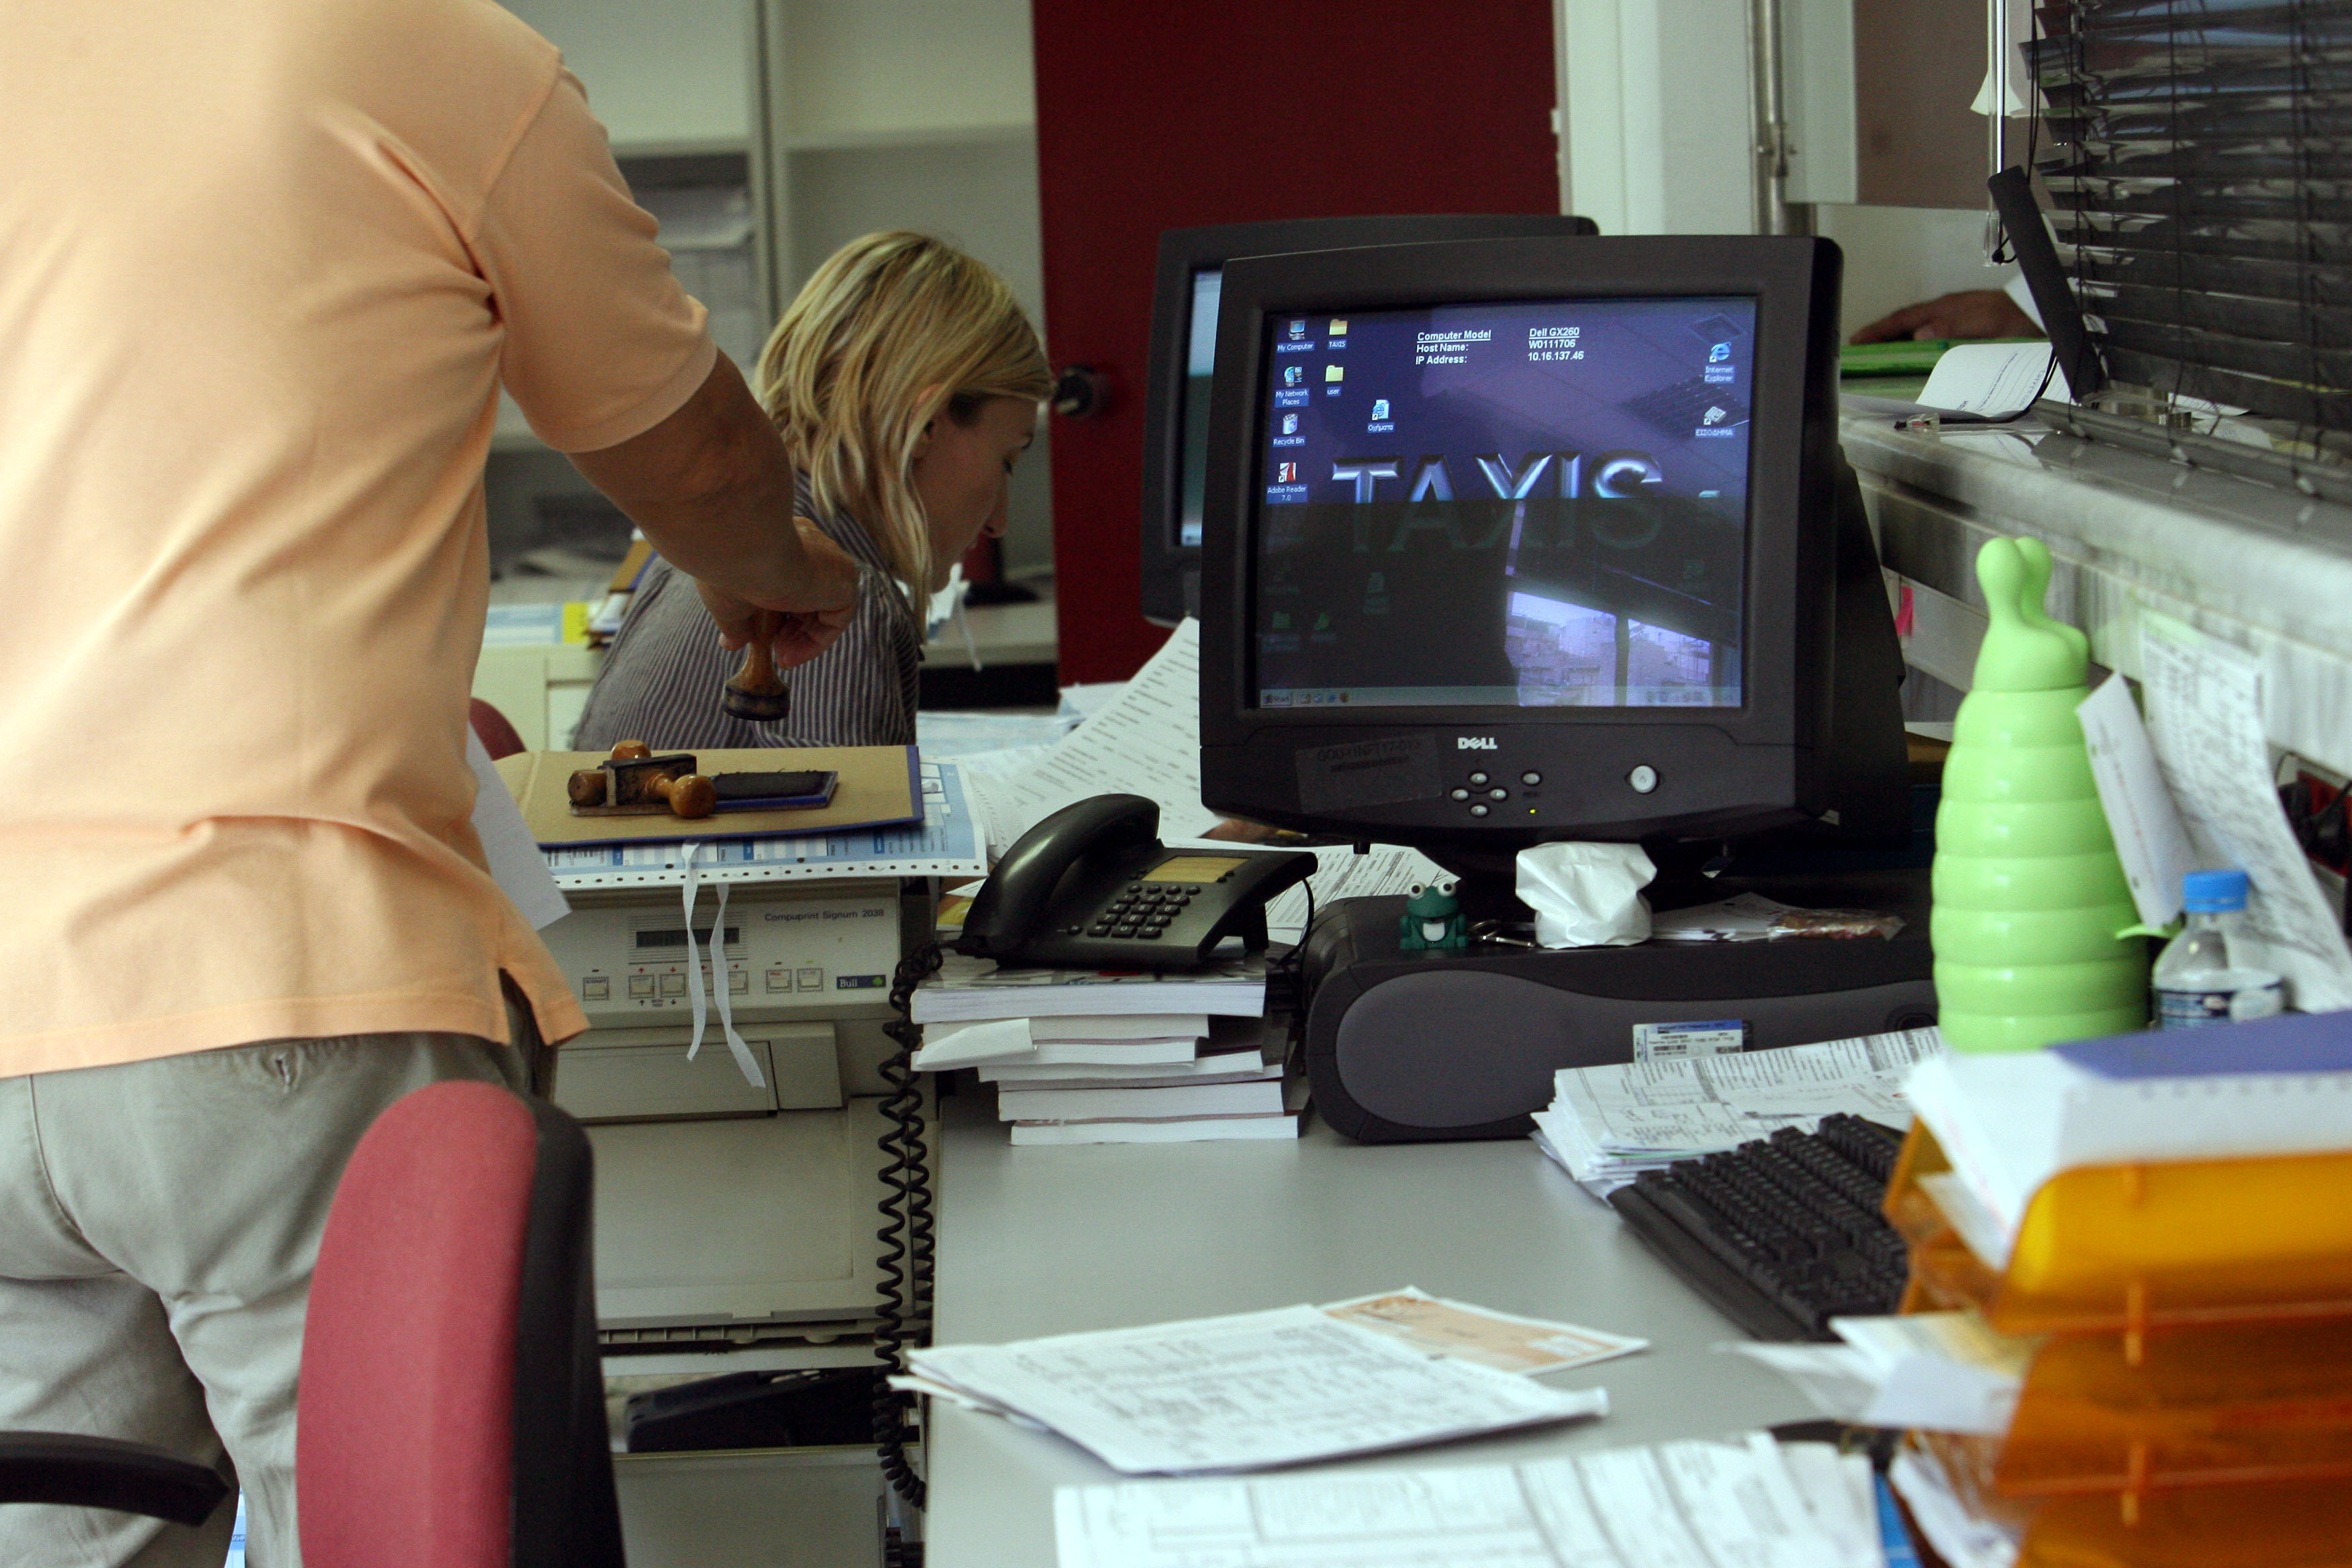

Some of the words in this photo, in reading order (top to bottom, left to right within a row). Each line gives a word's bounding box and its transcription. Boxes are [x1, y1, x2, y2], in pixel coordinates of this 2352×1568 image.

[1417, 332, 1462, 343] Computer
[1463, 330, 1491, 340] Model
[1529, 328, 1547, 336] Dell
[1549, 327, 1580, 336] GX260
[1416, 344, 1438, 352] Host
[1439, 342, 1469, 352] Name:
[1528, 339, 1576, 349] W0111706
[1416, 356, 1424, 364] IP
[1426, 354, 1467, 364] Address:
[1528, 351, 1584, 361] 10.16.137.46
[1285, 389, 1308, 397] Network
[1273, 438, 1294, 446] Recycle
[1332, 450, 1663, 551] TAXIS
[1457, 737, 1498, 750] DELL
[765, 912, 819, 922] Compuprint
[822, 910, 858, 920] Signum
[862, 908, 884, 918] 2038
[839, 979, 858, 988] Bull
